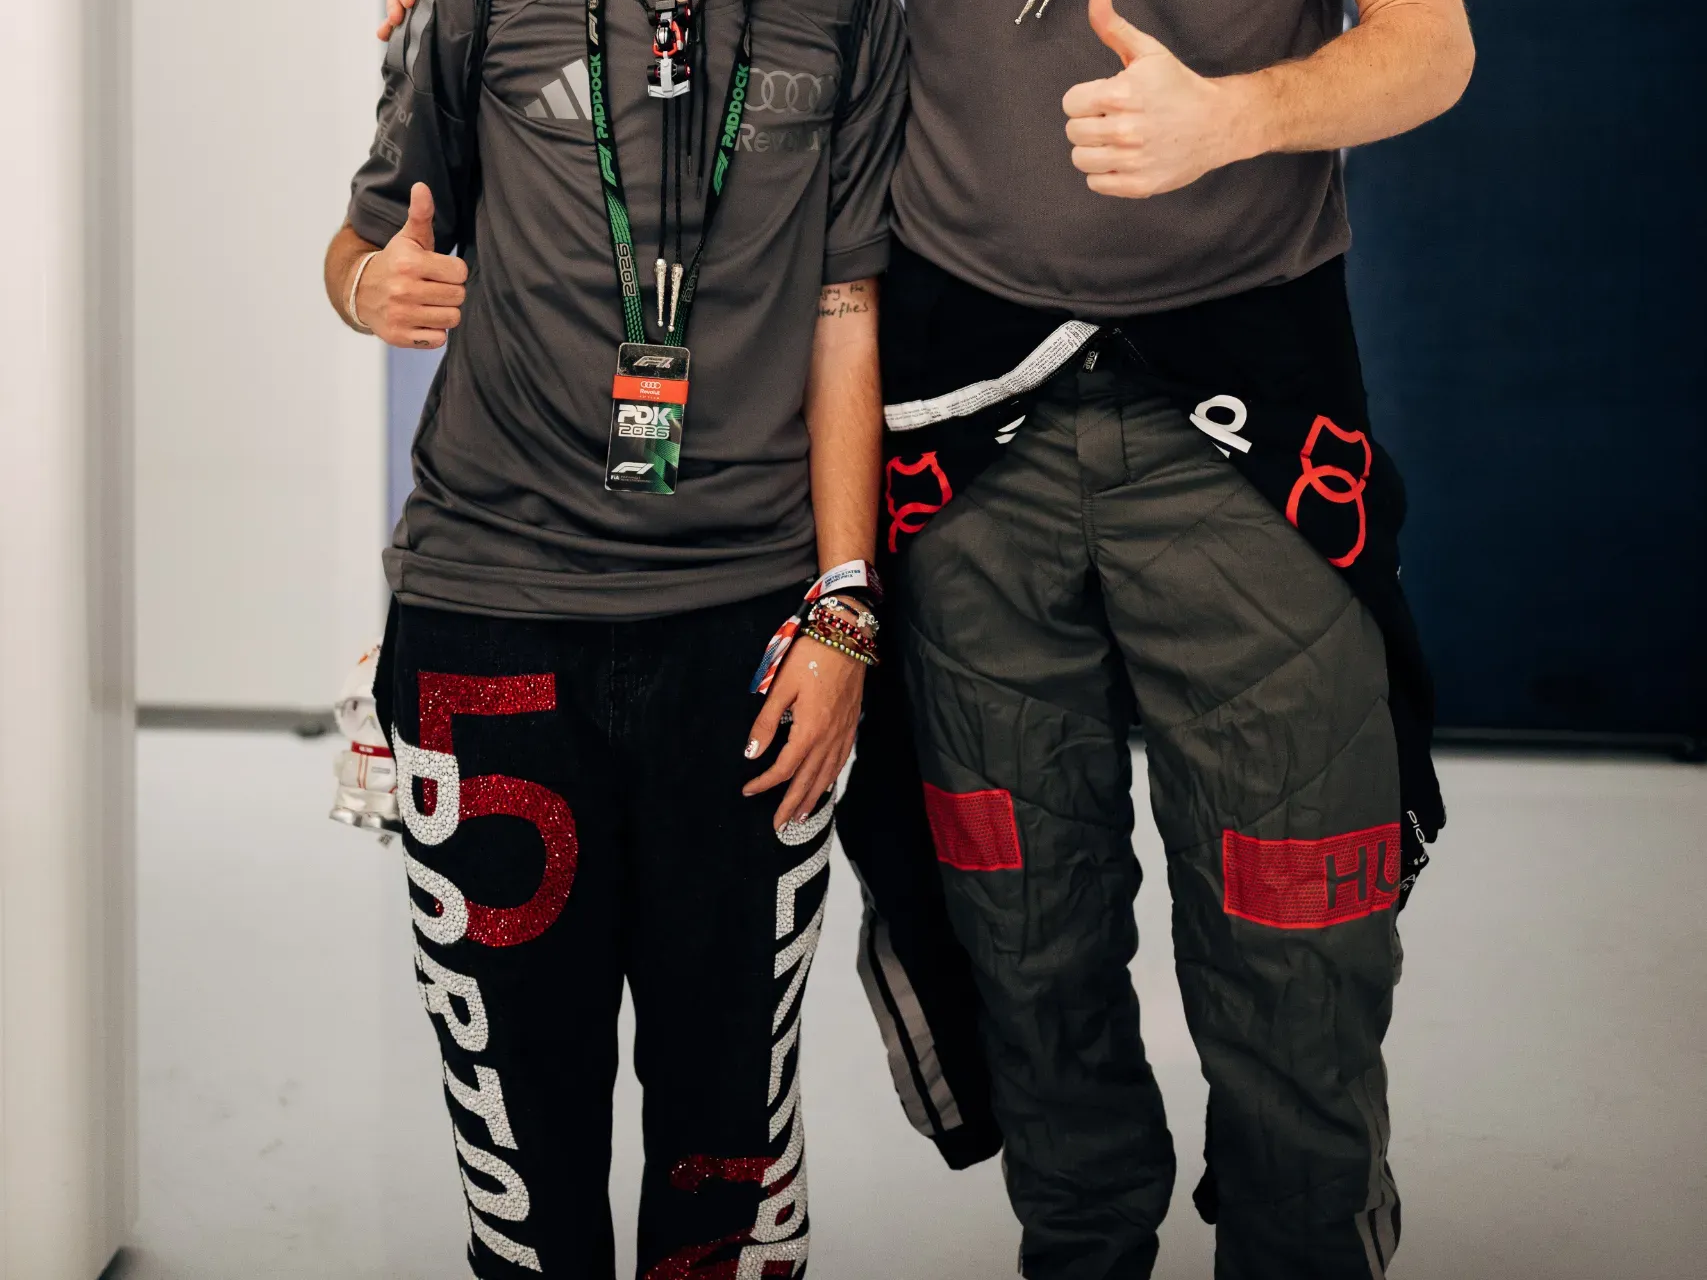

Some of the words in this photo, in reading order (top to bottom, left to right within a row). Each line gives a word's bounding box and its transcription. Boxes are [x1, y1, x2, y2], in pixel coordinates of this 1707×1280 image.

[589, 52, 609, 140] PADDOCK
[721, 62, 750, 148] PADDOCK
[615, 242, 638, 297] 2026
[617, 403, 672, 426] PDK
[618, 423, 670, 440] 2026
[418, 670, 580, 948] 5
